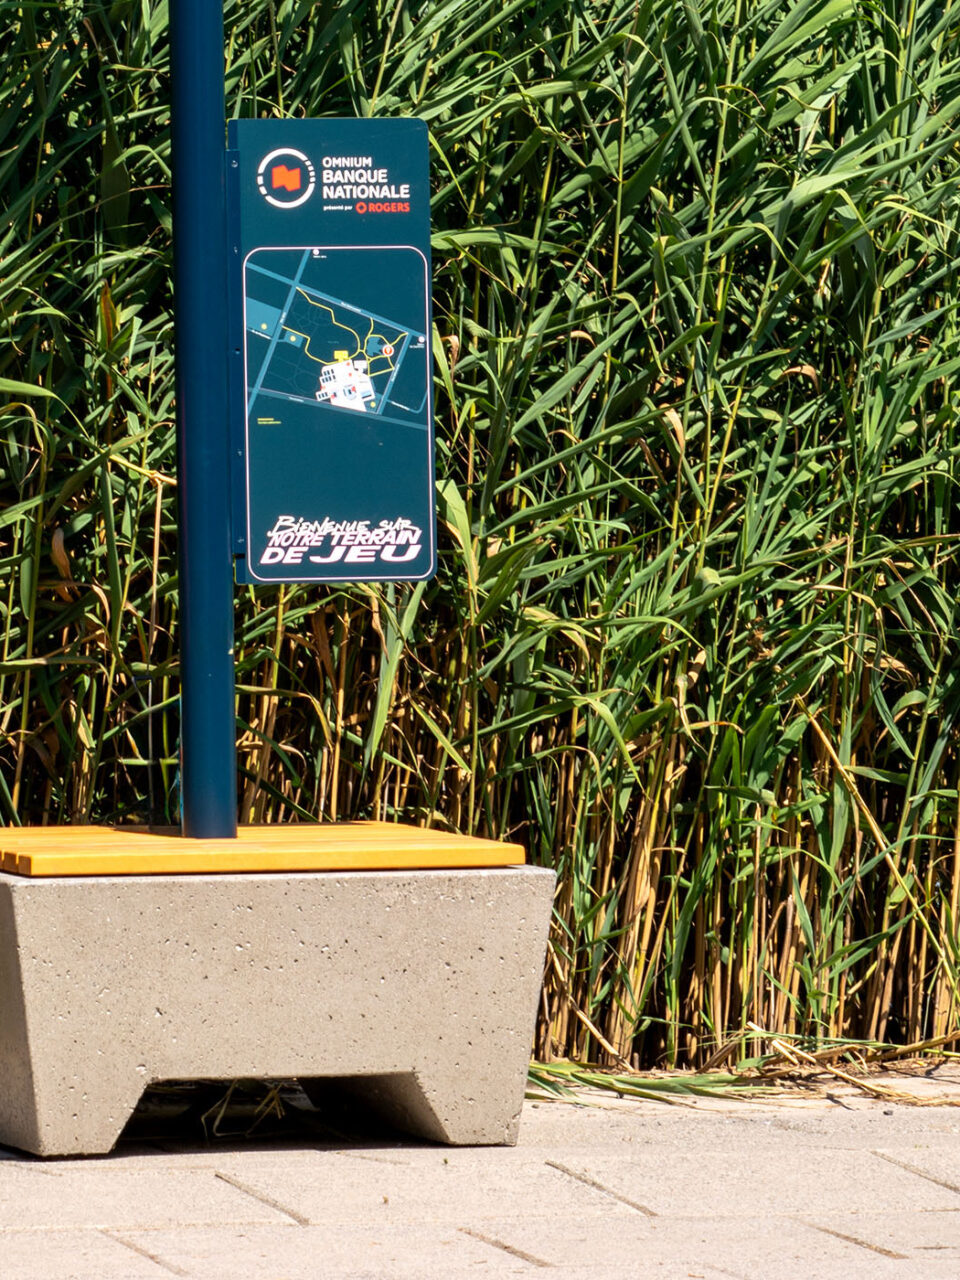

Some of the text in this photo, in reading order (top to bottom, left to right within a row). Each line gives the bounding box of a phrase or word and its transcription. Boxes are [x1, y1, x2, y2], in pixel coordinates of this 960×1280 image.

[322, 156, 372, 168] OMNIUM
[322, 169, 388, 185] BANQUE
[322, 184, 411, 199] NATIONALE
[368, 202, 411, 213] ROGERS
[268, 529, 423, 547] NOTRE TERRAIN
[260, 544, 423, 565] DE JEU
